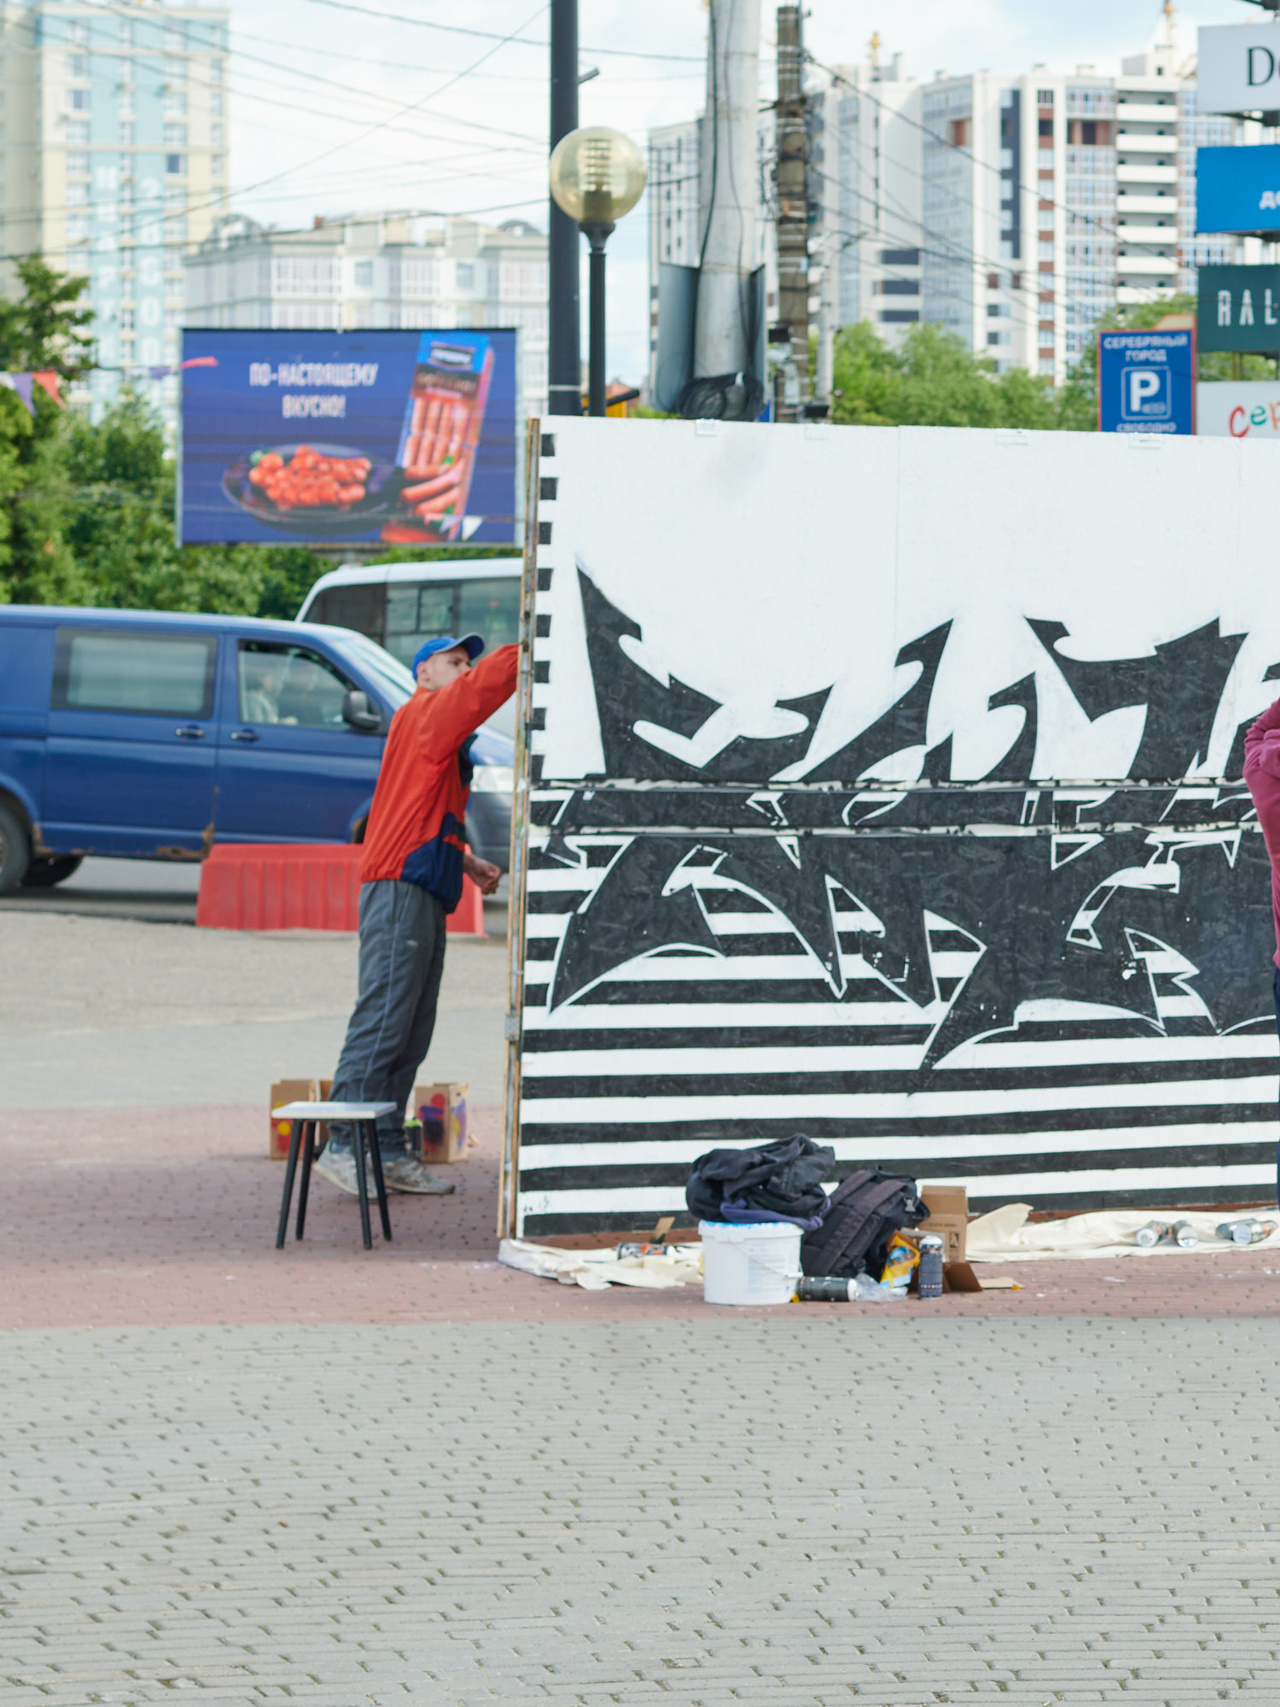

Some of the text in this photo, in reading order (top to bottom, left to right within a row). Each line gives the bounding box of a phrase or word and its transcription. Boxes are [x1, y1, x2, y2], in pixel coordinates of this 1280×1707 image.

[1103, 333, 1188, 350] СЕРЕБРЯНЫЙ
[1125, 349, 1167, 362] ГОРОД
[249, 362, 379, 387] ПО-НАСТОЯЩЕМУ
[1130, 371, 1160, 412] P
[282, 394, 347, 418] ВКУСНО!
